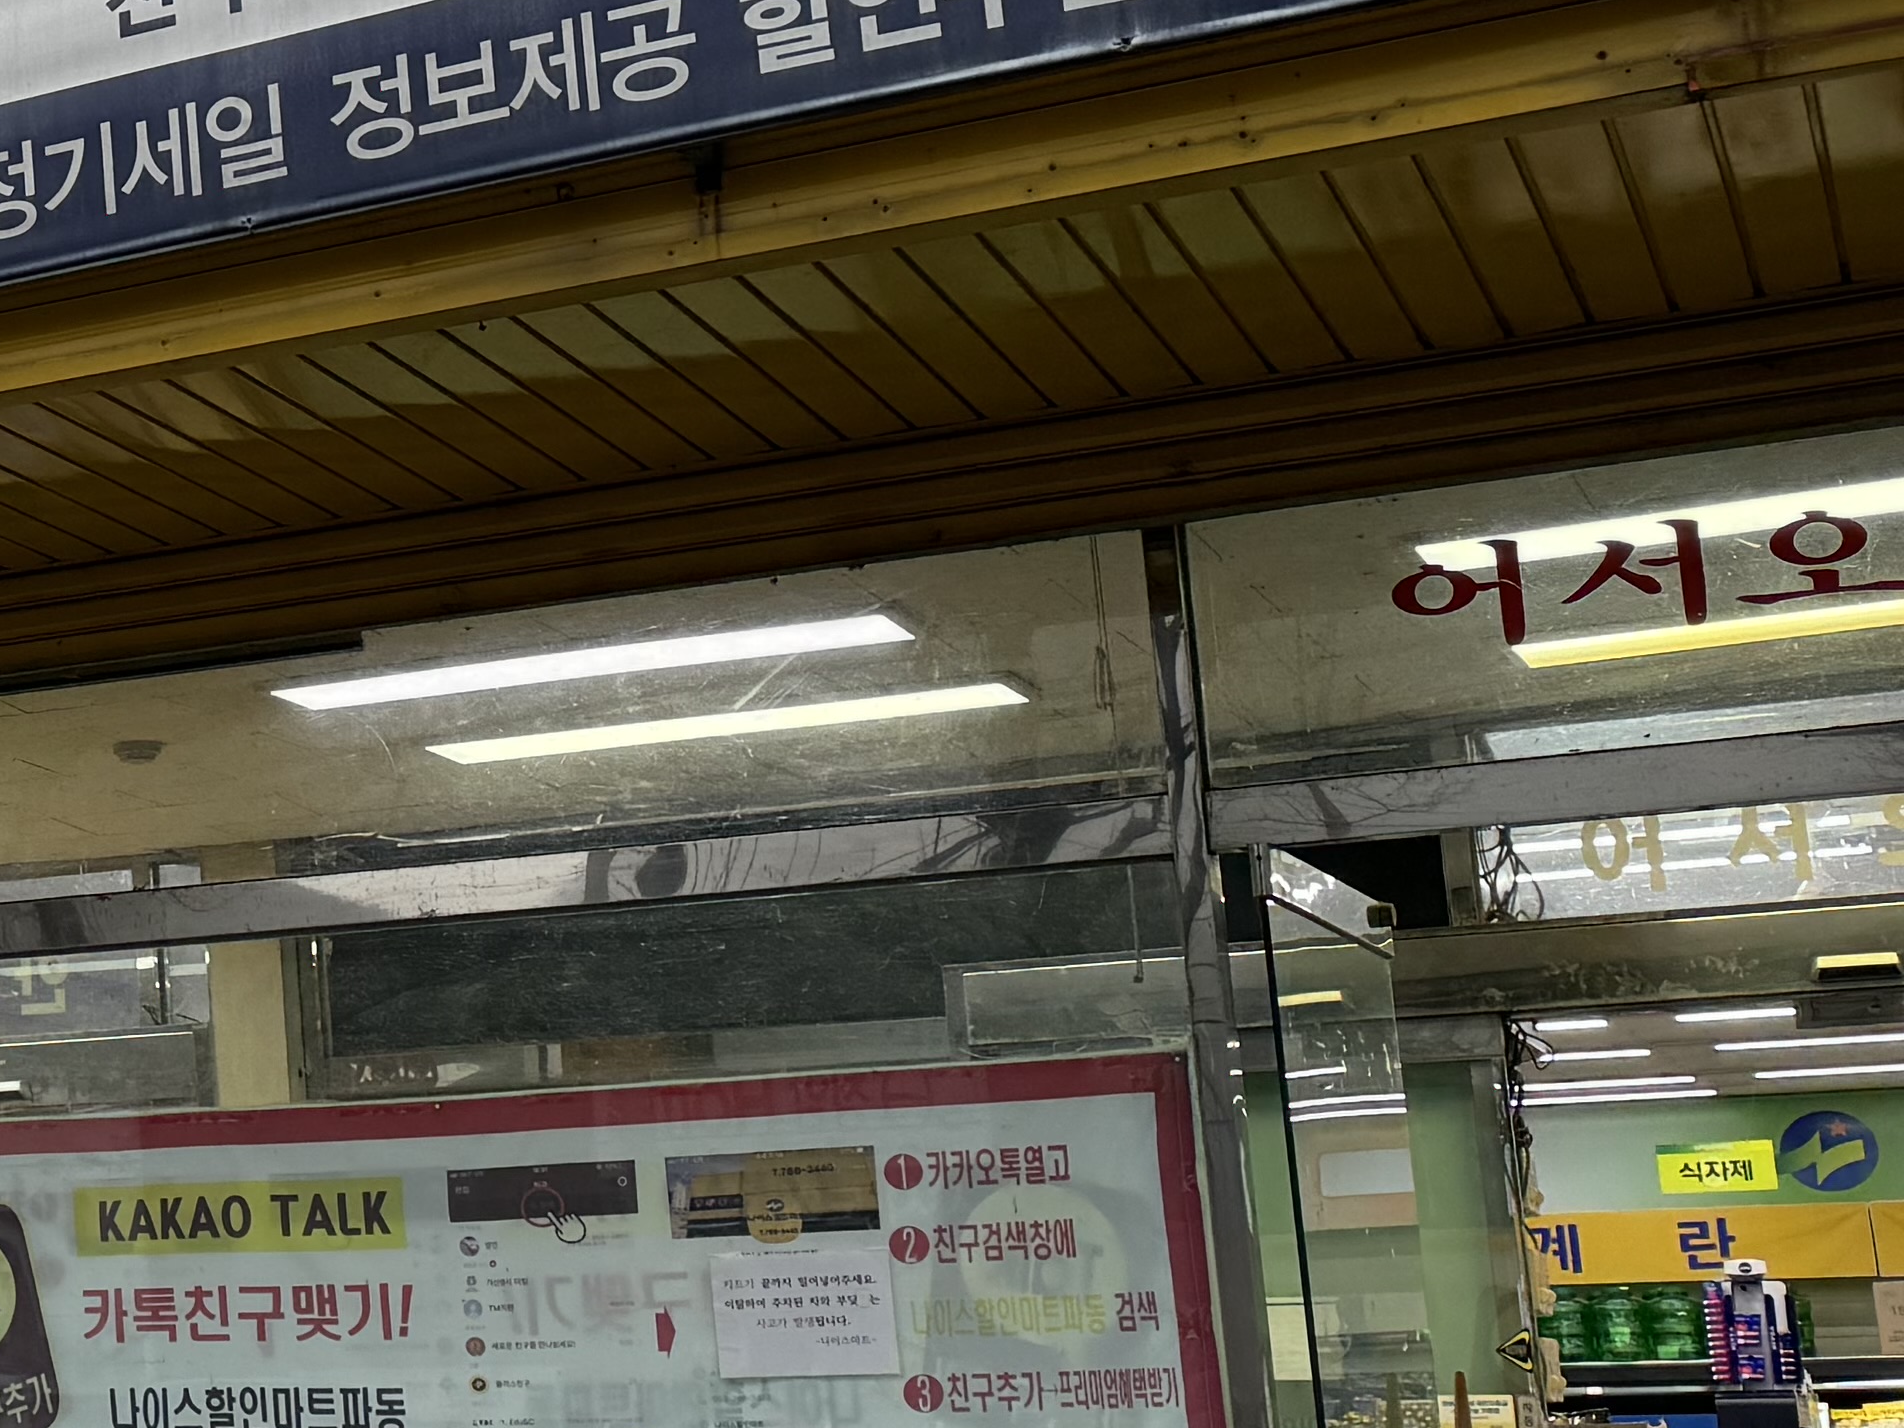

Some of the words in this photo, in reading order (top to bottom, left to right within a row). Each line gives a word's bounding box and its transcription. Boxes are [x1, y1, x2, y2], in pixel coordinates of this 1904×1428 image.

[926, 1145, 1071, 1189] 카카오톡열고
[98, 1194, 252, 1243] KAKAO
[270, 1190, 392, 1237] TALK
[934, 1219, 1076, 1263] 친구검색창에
[81, 1282, 415, 1343] 카톡친구맺기!
[1115, 1291, 1159, 1331] 검색
[947, 1372, 1043, 1412] 친구추가
